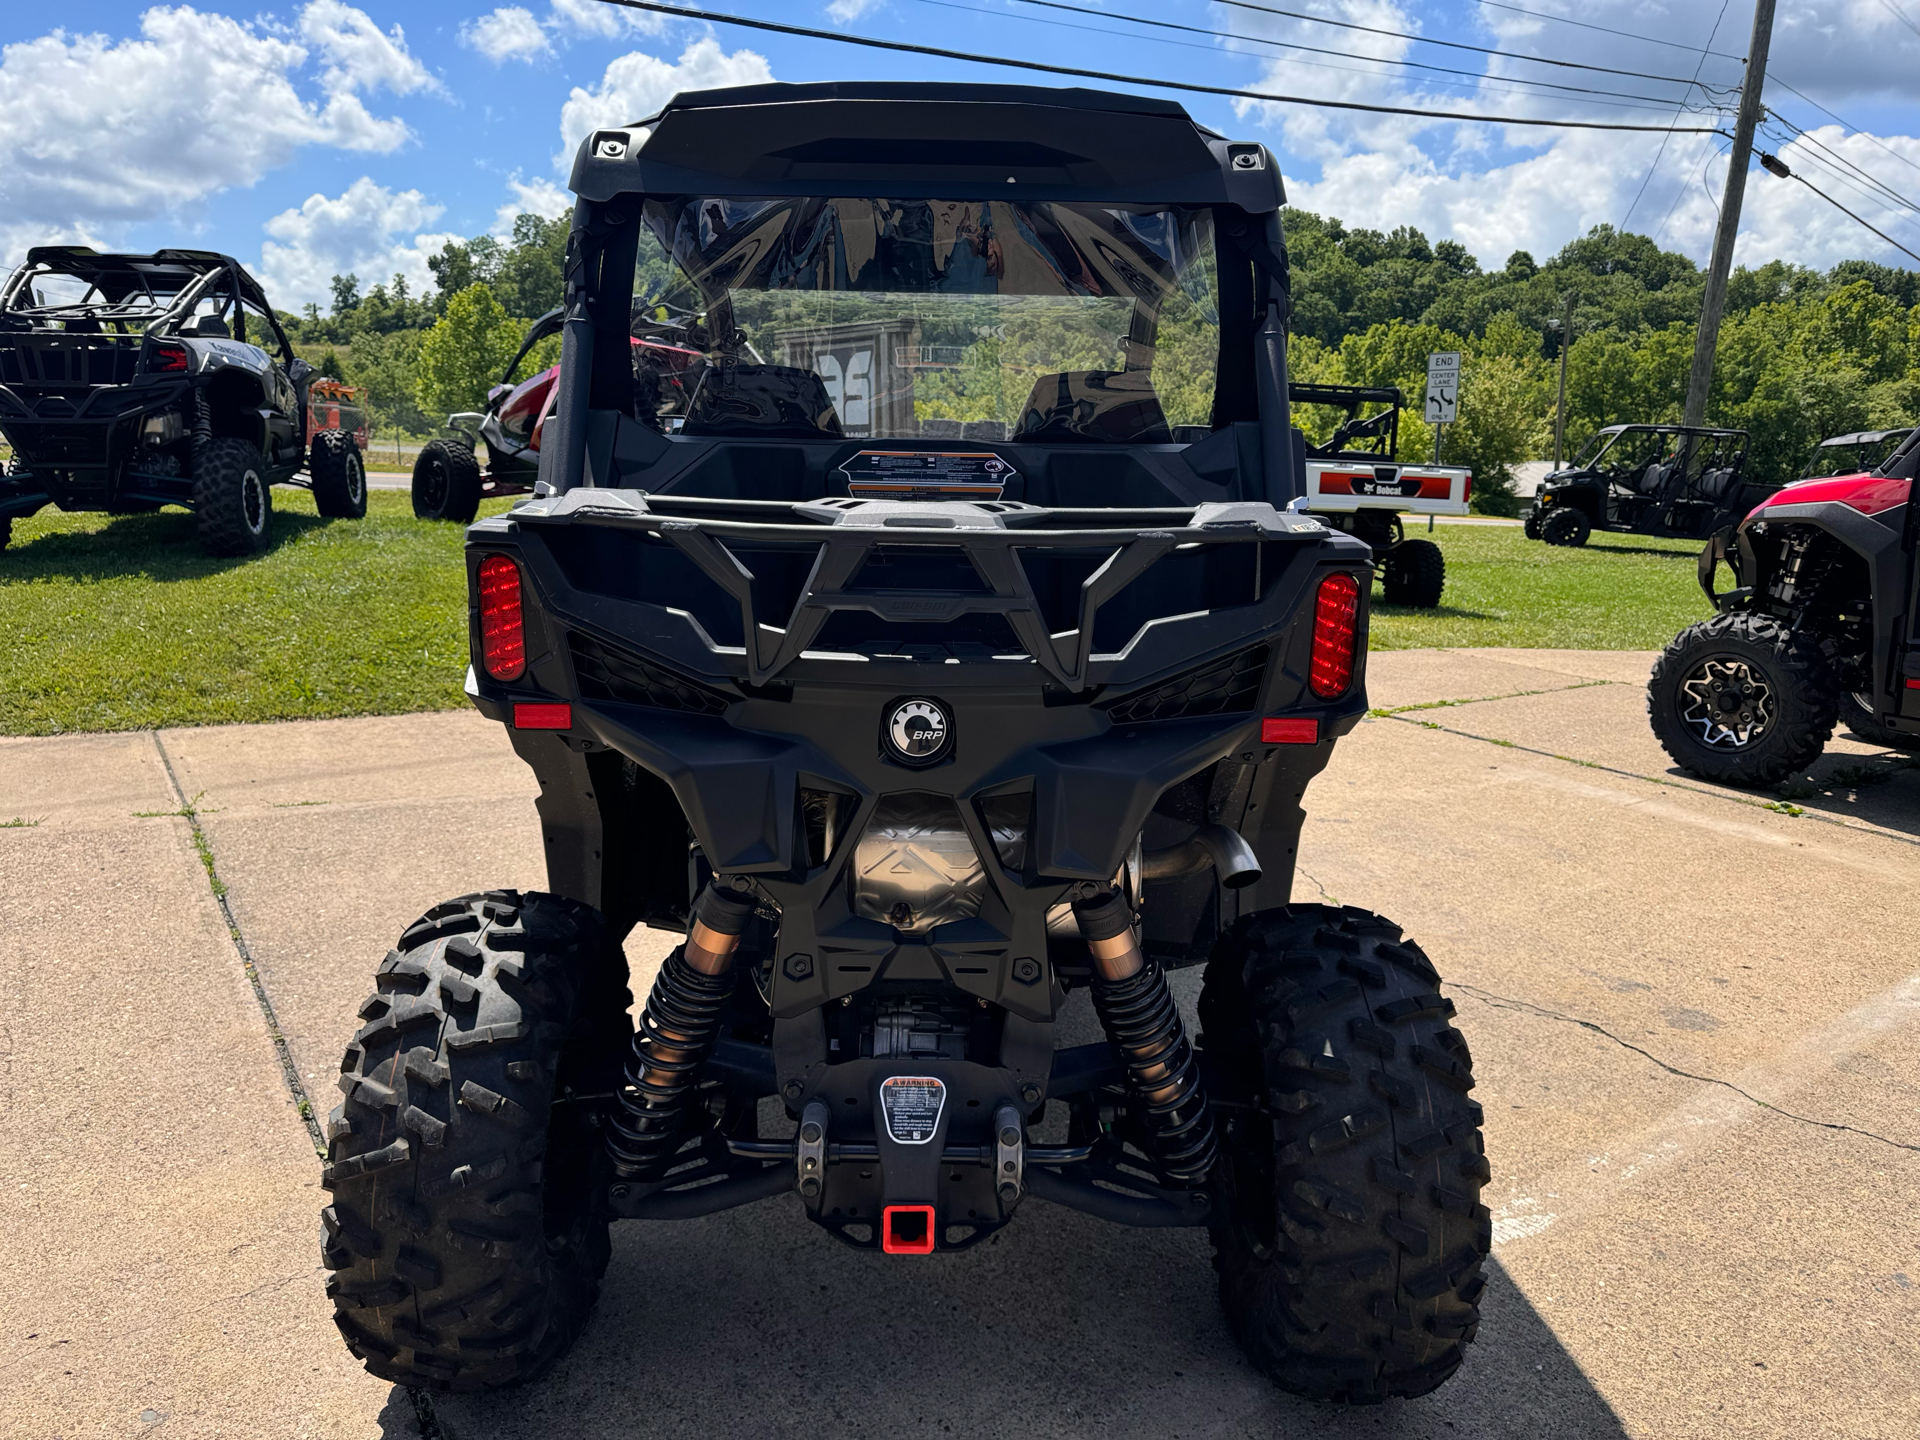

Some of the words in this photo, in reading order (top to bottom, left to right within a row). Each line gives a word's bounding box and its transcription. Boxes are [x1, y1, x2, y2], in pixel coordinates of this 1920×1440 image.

[1435, 357, 1453, 366] END
[1376, 485, 1402, 495] Bobcat
[913, 730, 943, 740] BRP
